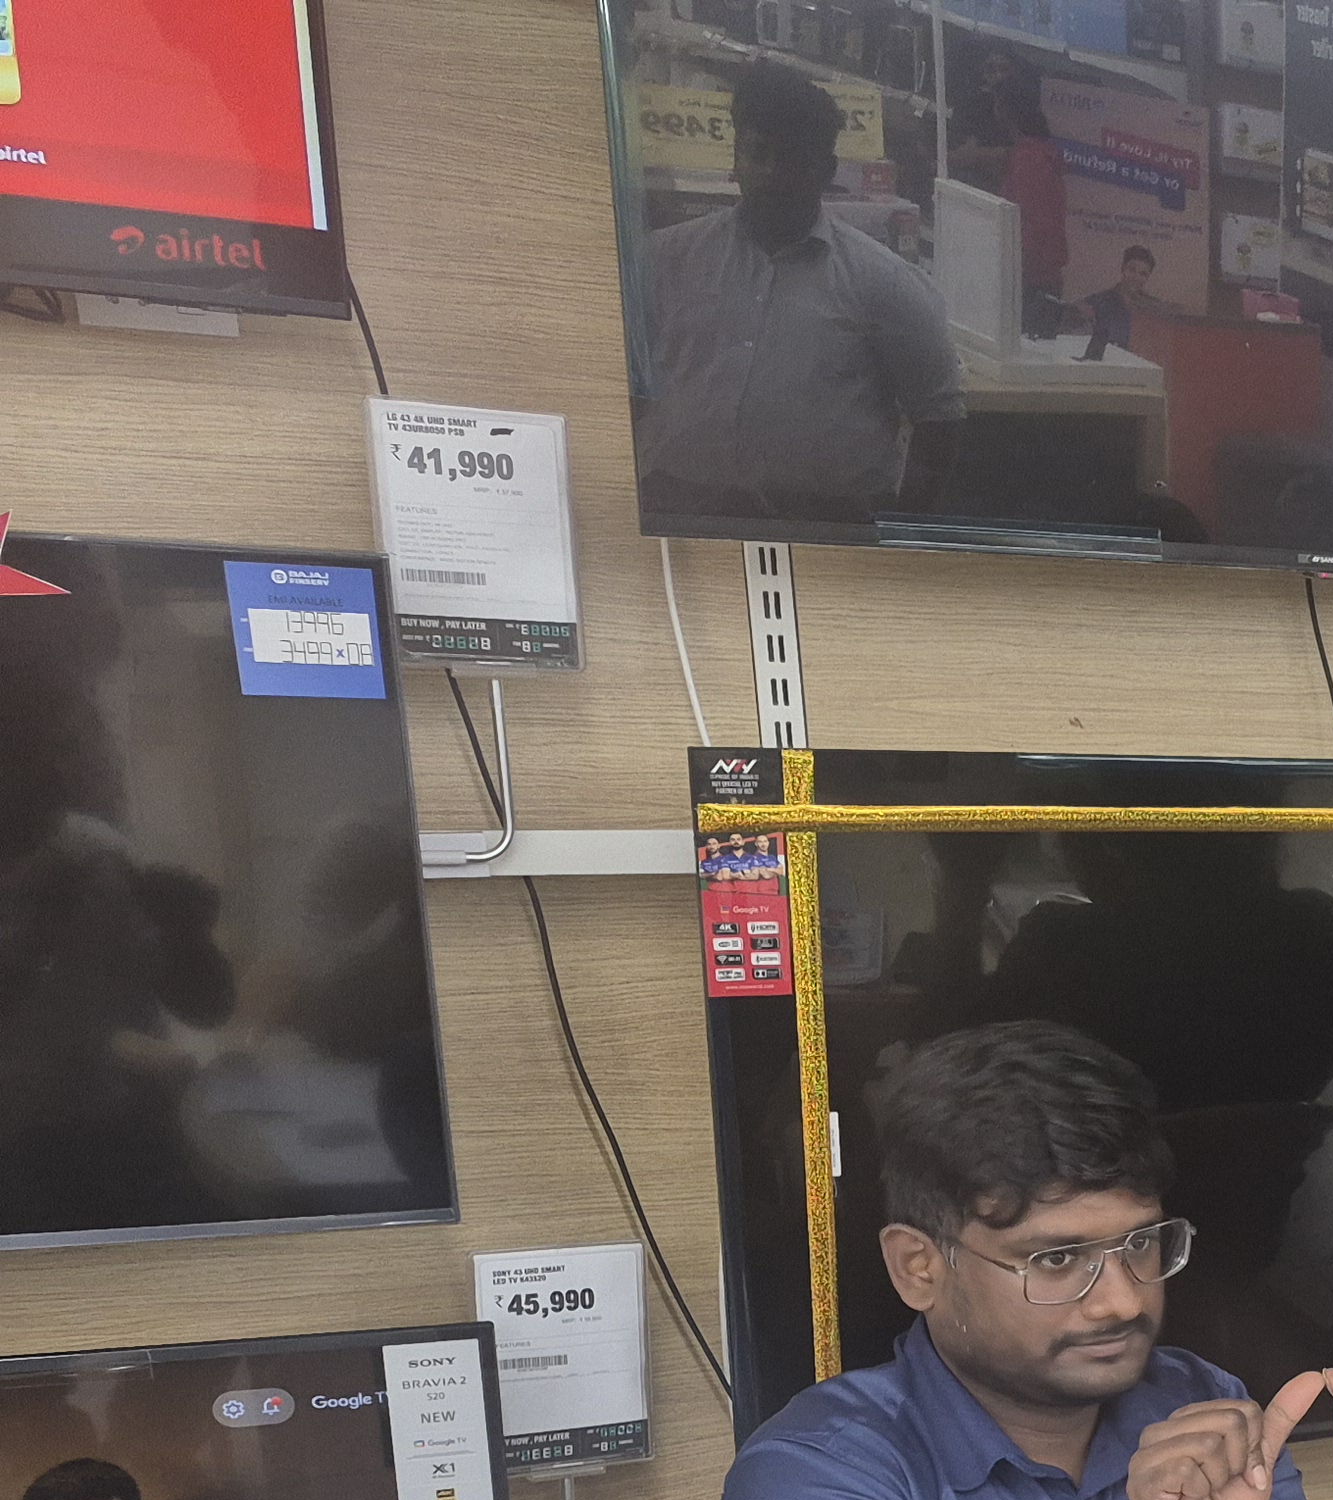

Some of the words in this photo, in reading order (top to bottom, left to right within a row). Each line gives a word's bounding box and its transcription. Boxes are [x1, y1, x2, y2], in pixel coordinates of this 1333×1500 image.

[156, 228, 266, 270] airtel
[386, 412, 398, 422] LG
[400, 414, 411, 423] 43
[448, 418, 477, 428] SMART
[388, 423, 398, 432] TV
[290, 596, 344, 607] AVAILABLE
[401, 618, 418, 628] BUY
[445, 620, 460, 629] PAY
[461, 621, 486, 630] LATER
[733, 905, 759, 915] Google
[760, 905, 770, 913] TV
[492, 1270, 511, 1278] SONY
[513, 1268, 523, 1276] 43
[524, 1267, 538, 1276] UHD
[541, 1265, 565, 1274] SMART
[493, 1277, 506, 1285] LED
[408, 1357, 456, 1368] SONY
[402, 1377, 457, 1390] BRAVIA
[460, 1376, 467, 1385] 2
[311, 1392, 373, 1410] Google
[374, 1391, 388, 1404] T
[427, 1392, 445, 1401] S20
[420, 1410, 456, 1424] NEW
[428, 1438, 455, 1447] Google
[534, 1435, 547, 1444] PAY
[549, 1432, 570, 1442] LATER
